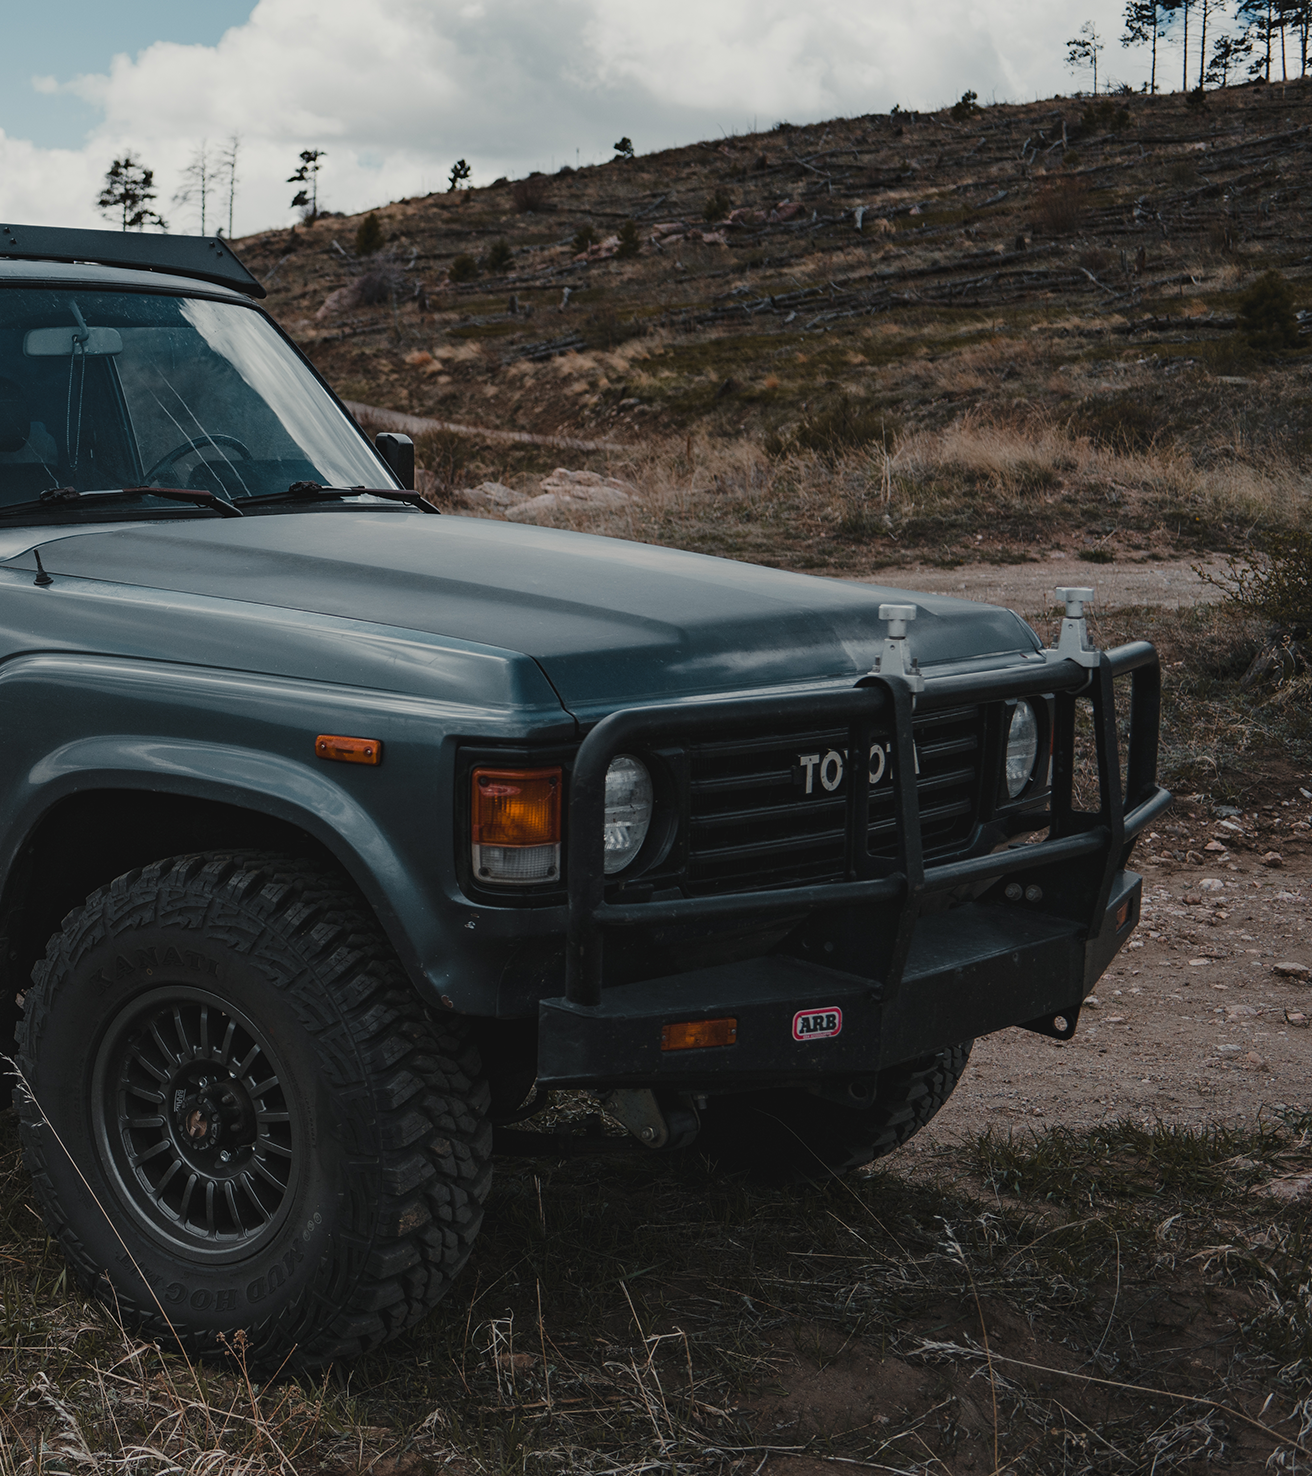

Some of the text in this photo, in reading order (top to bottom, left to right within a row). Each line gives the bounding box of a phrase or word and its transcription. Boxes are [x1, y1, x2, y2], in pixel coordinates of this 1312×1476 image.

[798, 738, 921, 795] TOO
[90, 946, 220, 996] KANATI
[799, 1013, 837, 1034] ARB
[246, 1237, 308, 1304] MUD
[164, 1281, 239, 1312] HOG
